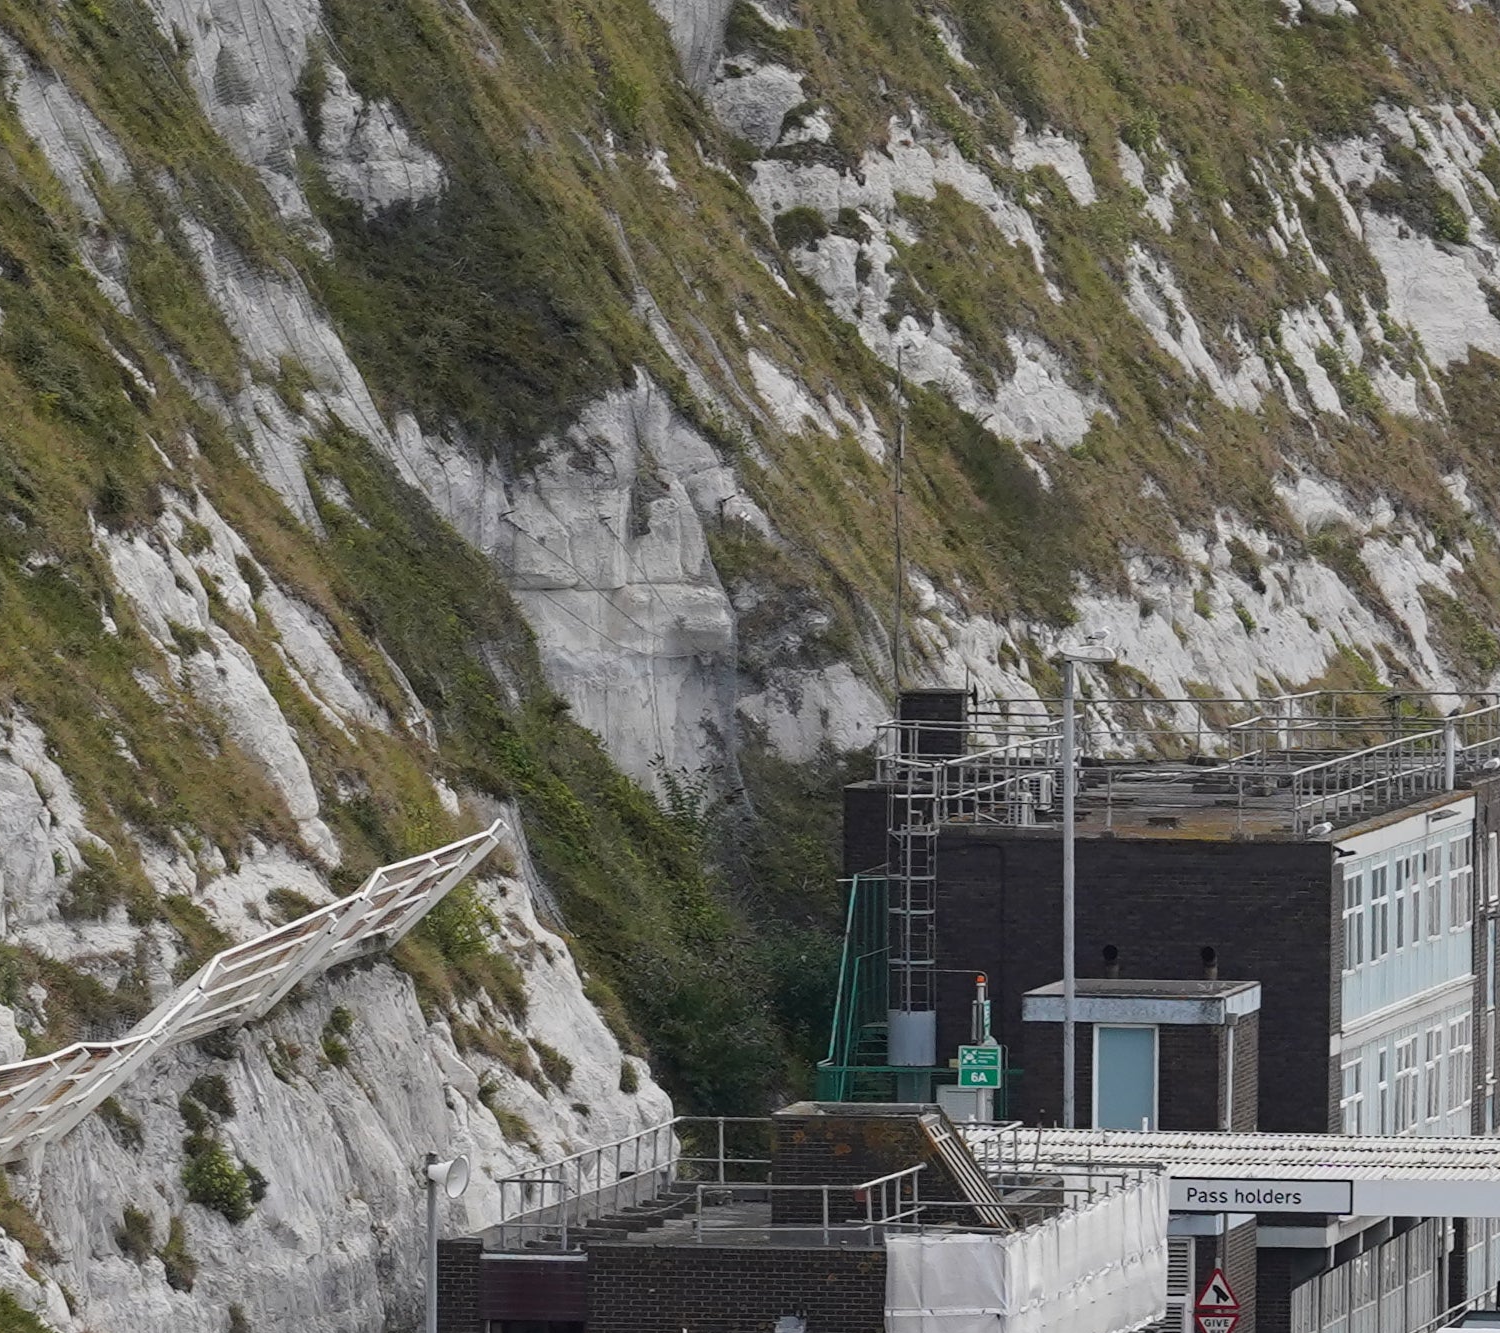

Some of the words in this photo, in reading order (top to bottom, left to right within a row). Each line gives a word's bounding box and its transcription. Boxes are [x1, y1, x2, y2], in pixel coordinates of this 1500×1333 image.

[970, 1071, 988, 1083] 6A
[1187, 1188, 1229, 1204] Pass
[1235, 1189, 1302, 1205] holders
[1203, 1318, 1230, 1327] GIVE
